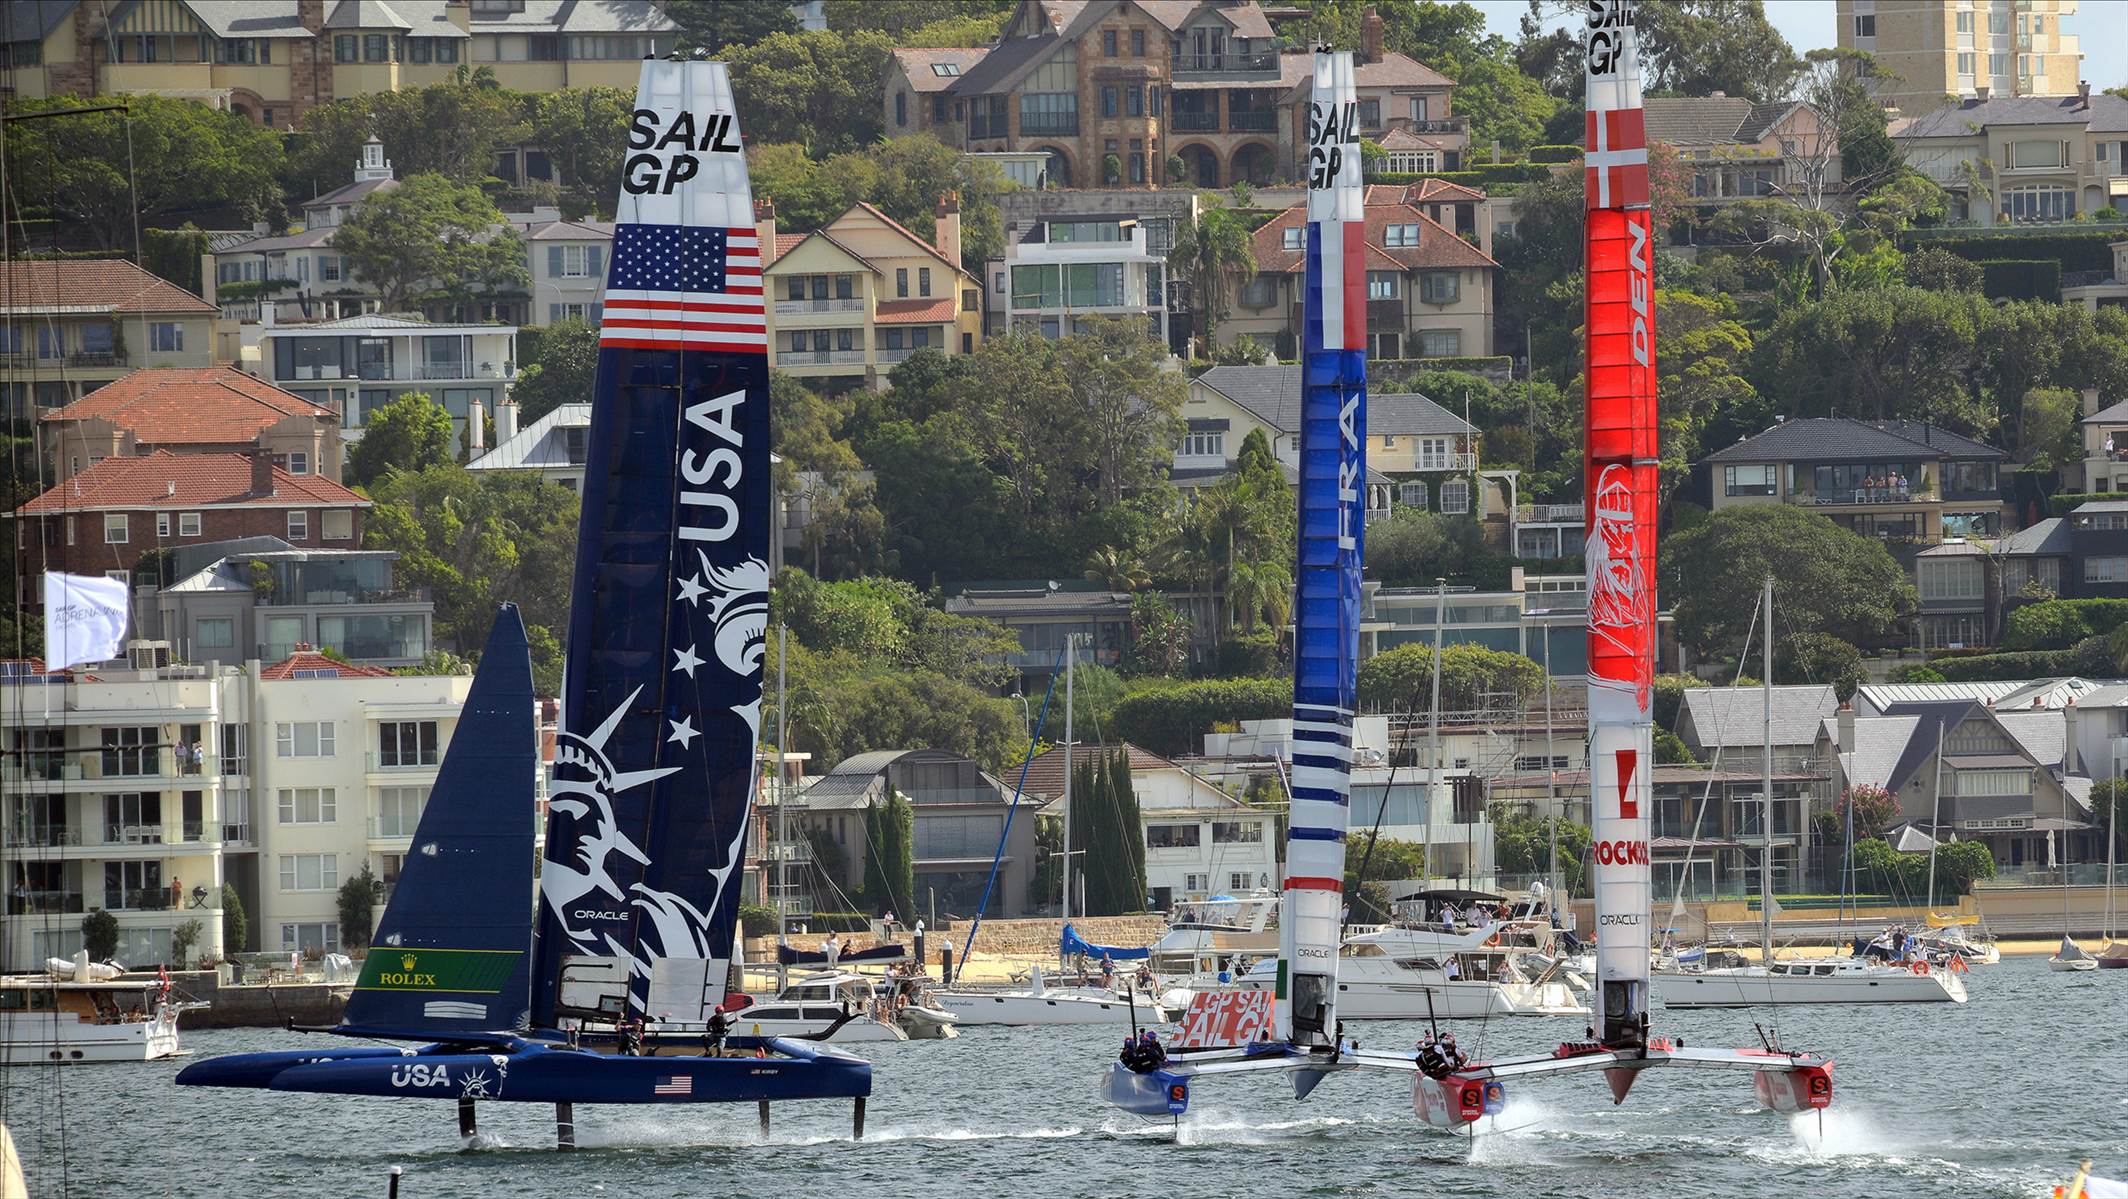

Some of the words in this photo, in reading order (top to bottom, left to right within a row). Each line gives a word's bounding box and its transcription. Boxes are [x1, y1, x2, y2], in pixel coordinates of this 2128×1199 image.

[1588, 0, 1634, 29] SAIL
[1589, 31, 1622, 75] GP
[628, 109, 741, 153] SAIL
[1310, 103, 1359, 145] SAIL
[622, 153, 699, 195] GP
[1309, 147, 1342, 189] GP
[1628, 220, 1649, 368] DEN
[678, 389, 746, 542] USA
[1338, 392, 1359, 550] FRA
[574, 910, 629, 920] ORACLE
[1297, 949, 1328, 959] ORACLE
[380, 973, 436, 985] ROLEX
[391, 1064, 451, 1087] USA
